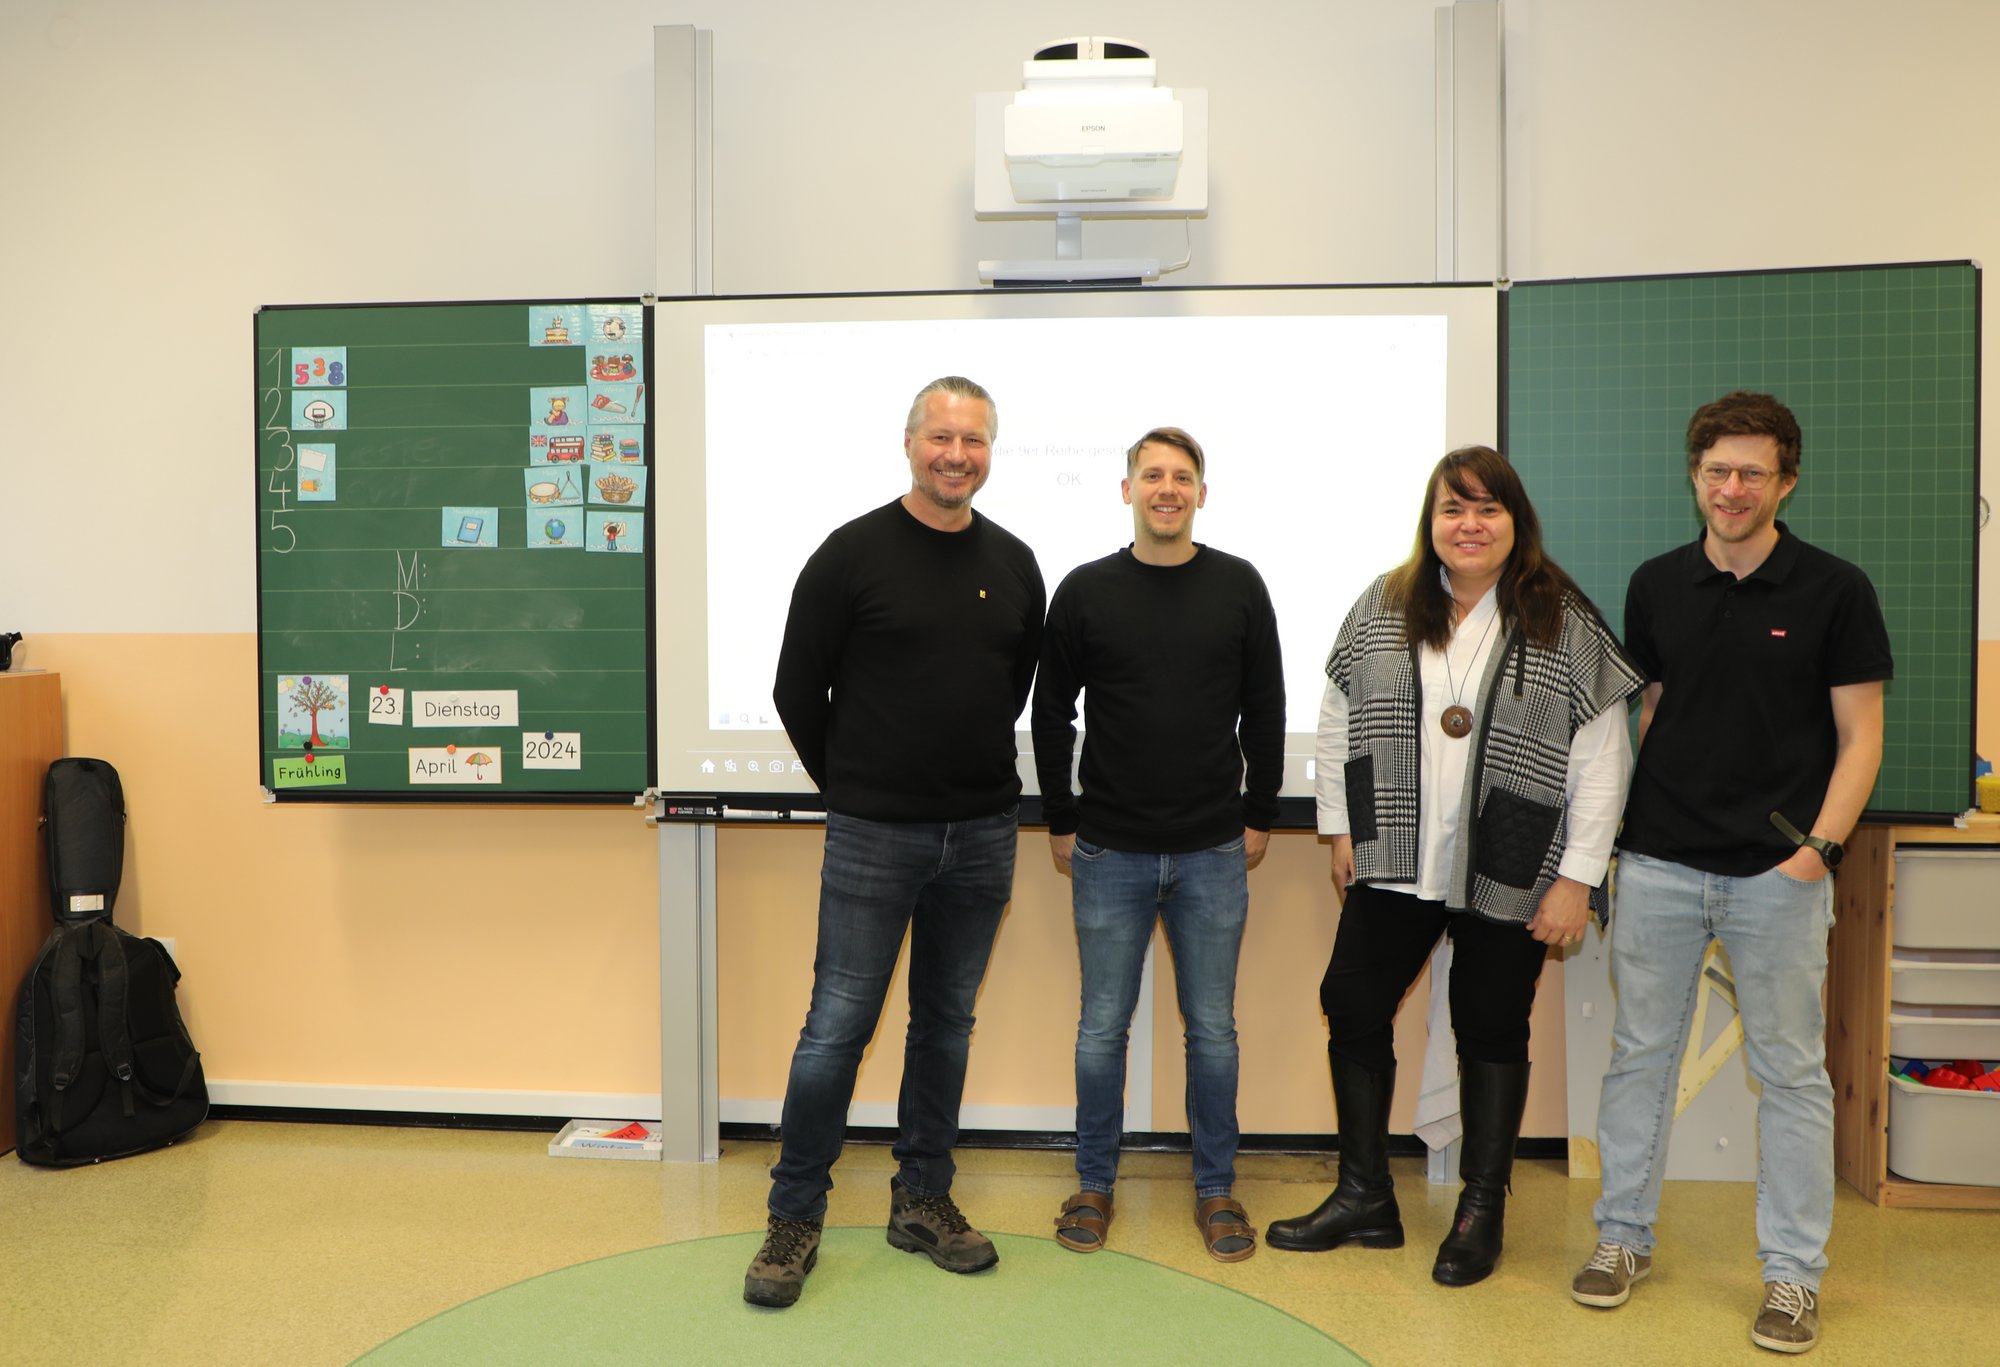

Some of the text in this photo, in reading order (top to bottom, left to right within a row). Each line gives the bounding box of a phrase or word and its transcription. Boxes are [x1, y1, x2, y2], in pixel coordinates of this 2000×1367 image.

[1081, 124, 1106, 132] EPSON
[265, 349, 283, 389] 1
[295, 357, 344, 385] 5 3 8
[264, 388, 288, 430] 2
[267, 429, 295, 471] 3
[993, 445, 1014, 457] die
[1045, 444, 1085, 457] Reihe
[1056, 472, 1082, 486] OK
[268, 471, 292, 510] 4
[271, 509, 296, 554] 5
[371, 696, 402, 716] 23.
[425, 700, 501, 720] Dienstag
[525, 741, 578, 760] 2024
[278, 764, 342, 780] Frühling
[415, 758, 457, 777] April
